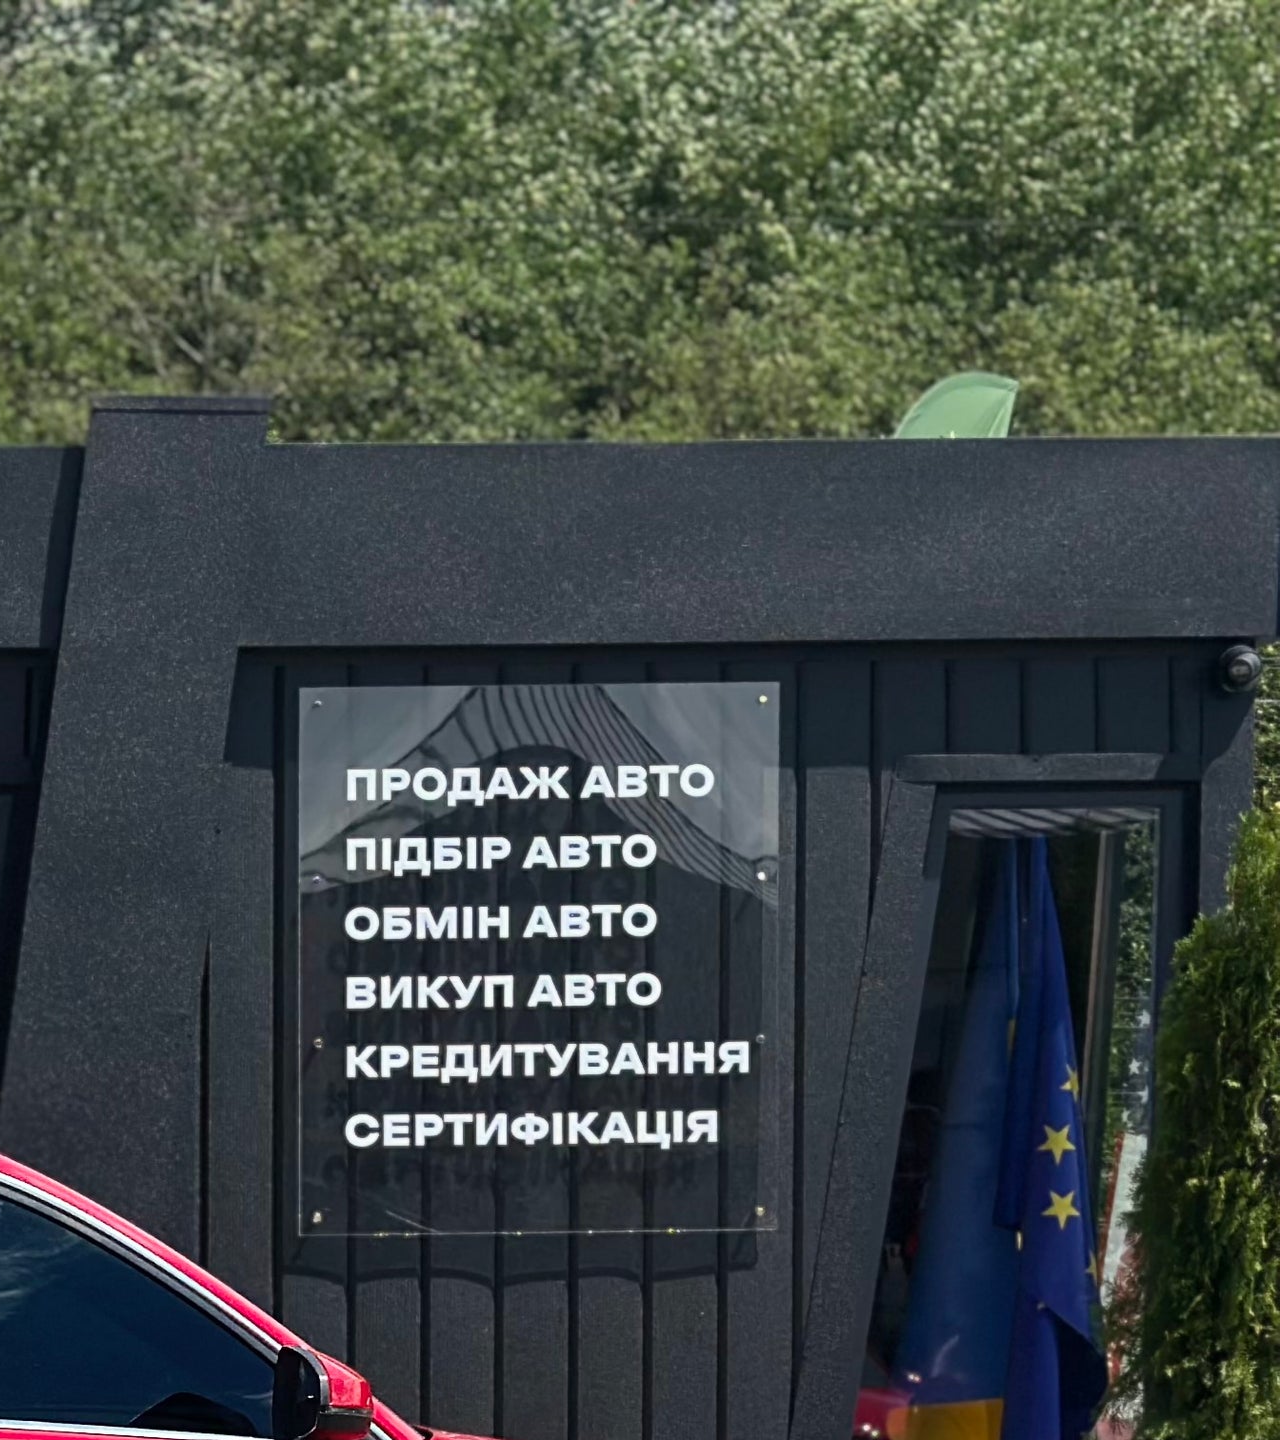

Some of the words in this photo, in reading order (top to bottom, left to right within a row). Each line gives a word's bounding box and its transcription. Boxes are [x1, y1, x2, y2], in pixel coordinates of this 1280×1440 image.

[345, 765, 571, 808] ПРОДАЖ
[579, 762, 716, 800] АВТО
[345, 835, 513, 878] ПІДБІР
[521, 832, 658, 870] АВТО
[343, 905, 511, 942] ОБМІН
[522, 902, 658, 939] АВТО
[345, 973, 515, 1010] ВИКУП
[526, 971, 663, 1009] АВТО
[345, 1040, 751, 1084] КРЕДИТУВАННЯ
[344, 1109, 719, 1151] СЕРТИФІКАЦІЯ
